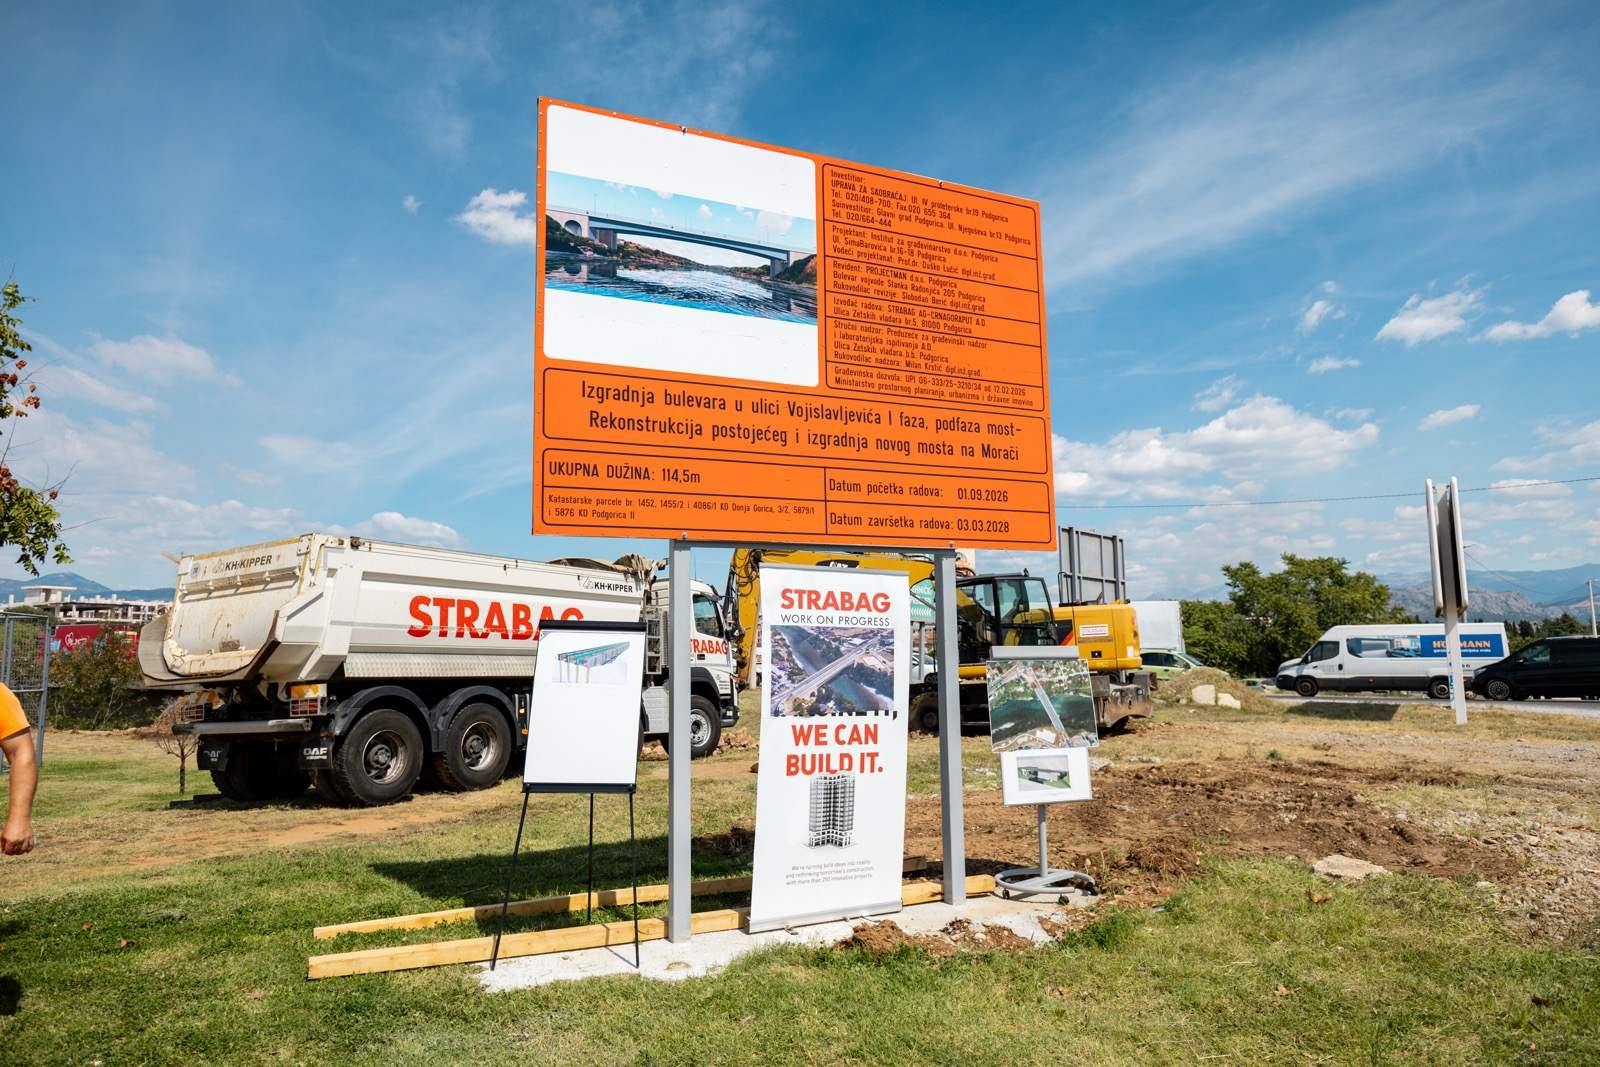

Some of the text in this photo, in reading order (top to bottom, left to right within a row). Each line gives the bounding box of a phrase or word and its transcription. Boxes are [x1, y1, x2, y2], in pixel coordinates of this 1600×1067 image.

[831, 179, 856, 191] UPRAVA
[858, 184, 867, 194] ZA
[981, 210, 1008, 223] Podgorica
[896, 238, 904, 246] za
[971, 250, 998, 262] Podgorica
[917, 250, 946, 263] Podgorica
[865, 265, 907, 280] PROJECTMAN
[928, 276, 957, 289] Podgorica
[958, 290, 986, 303] Podgorica
[887, 304, 916, 317] STRABAG
[943, 322, 973, 337] Podgorica
[967, 338, 987, 349] nadzor
[905, 359, 921, 369] Milan
[919, 351, 949, 363] Podgorica
[582, 380, 654, 407] Izgradnja
[664, 388, 726, 410] bulevara
[735, 399, 742, 412] u
[751, 398, 779, 415] ulici
[787, 400, 881, 425] Vojislavljevića
[899, 411, 928, 430] faza,
[935, 417, 980, 433] podfaza
[987, 423, 1021, 436] most-
[589, 410, 702, 439] Rekonstrukcija
[712, 423, 787, 447] postojećeg
[808, 429, 868, 452] izgradnja
[876, 438, 910, 456] novog
[917, 441, 954, 456] mosta
[961, 445, 975, 457] na
[981, 443, 1018, 460] Morači
[549, 461, 700, 483] UKUPNA DUŽINA: 114,5m
[829, 478, 1008, 502] Datum početka radova: 01.09.2026
[548, 494, 592, 505] Katastarske
[596, 497, 622, 506] parcele
[660, 499, 684, 509] 1455/2
[720, 502, 729, 511] KO
[555, 507, 575, 517] 5876
[578, 508, 588, 517] KO
[591, 509, 626, 520] Podgorica
[830, 512, 1009, 533] Datum završetka radova: 03.03.2028
[225, 555, 272, 571] KH-KIPPER
[594, 582, 633, 593] KH-KIPPER
[780, 588, 891, 613] STRABAG
[781, 614, 890, 626] WORK ON PROGRESS
[791, 723, 879, 746] WE CAN
[303, 747, 328, 756] DAF
[786, 752, 883, 776] BUILD IT.
